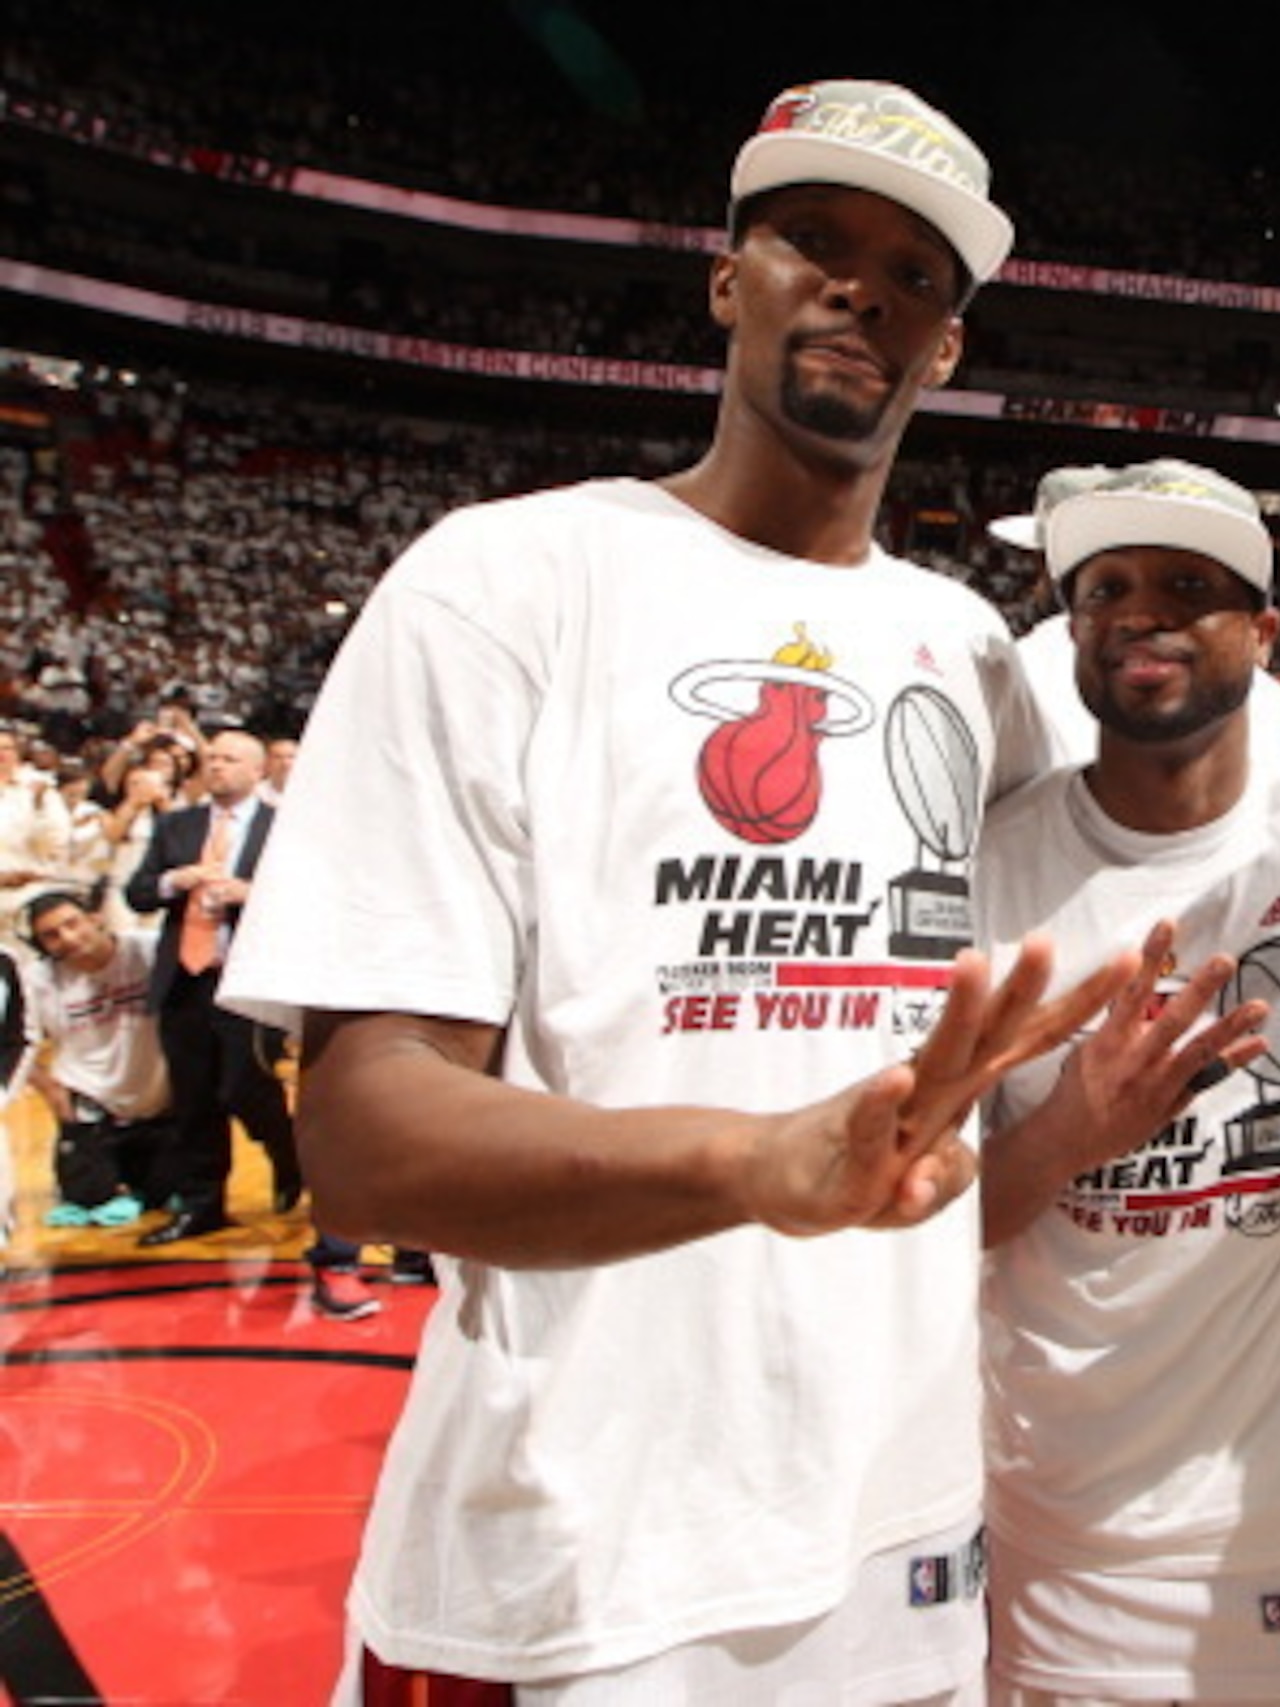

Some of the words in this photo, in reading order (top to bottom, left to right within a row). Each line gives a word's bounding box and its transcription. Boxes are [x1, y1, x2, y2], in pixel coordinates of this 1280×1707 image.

[654, 855, 863, 905] MIAMI
[698, 897, 883, 957] HEAT
[662, 995, 741, 1034] SEE
[754, 993, 829, 1030] YOU
[840, 993, 879, 1029] IN
[1112, 1211, 1171, 1237] YOU
[1178, 1203, 1211, 1233] IN
